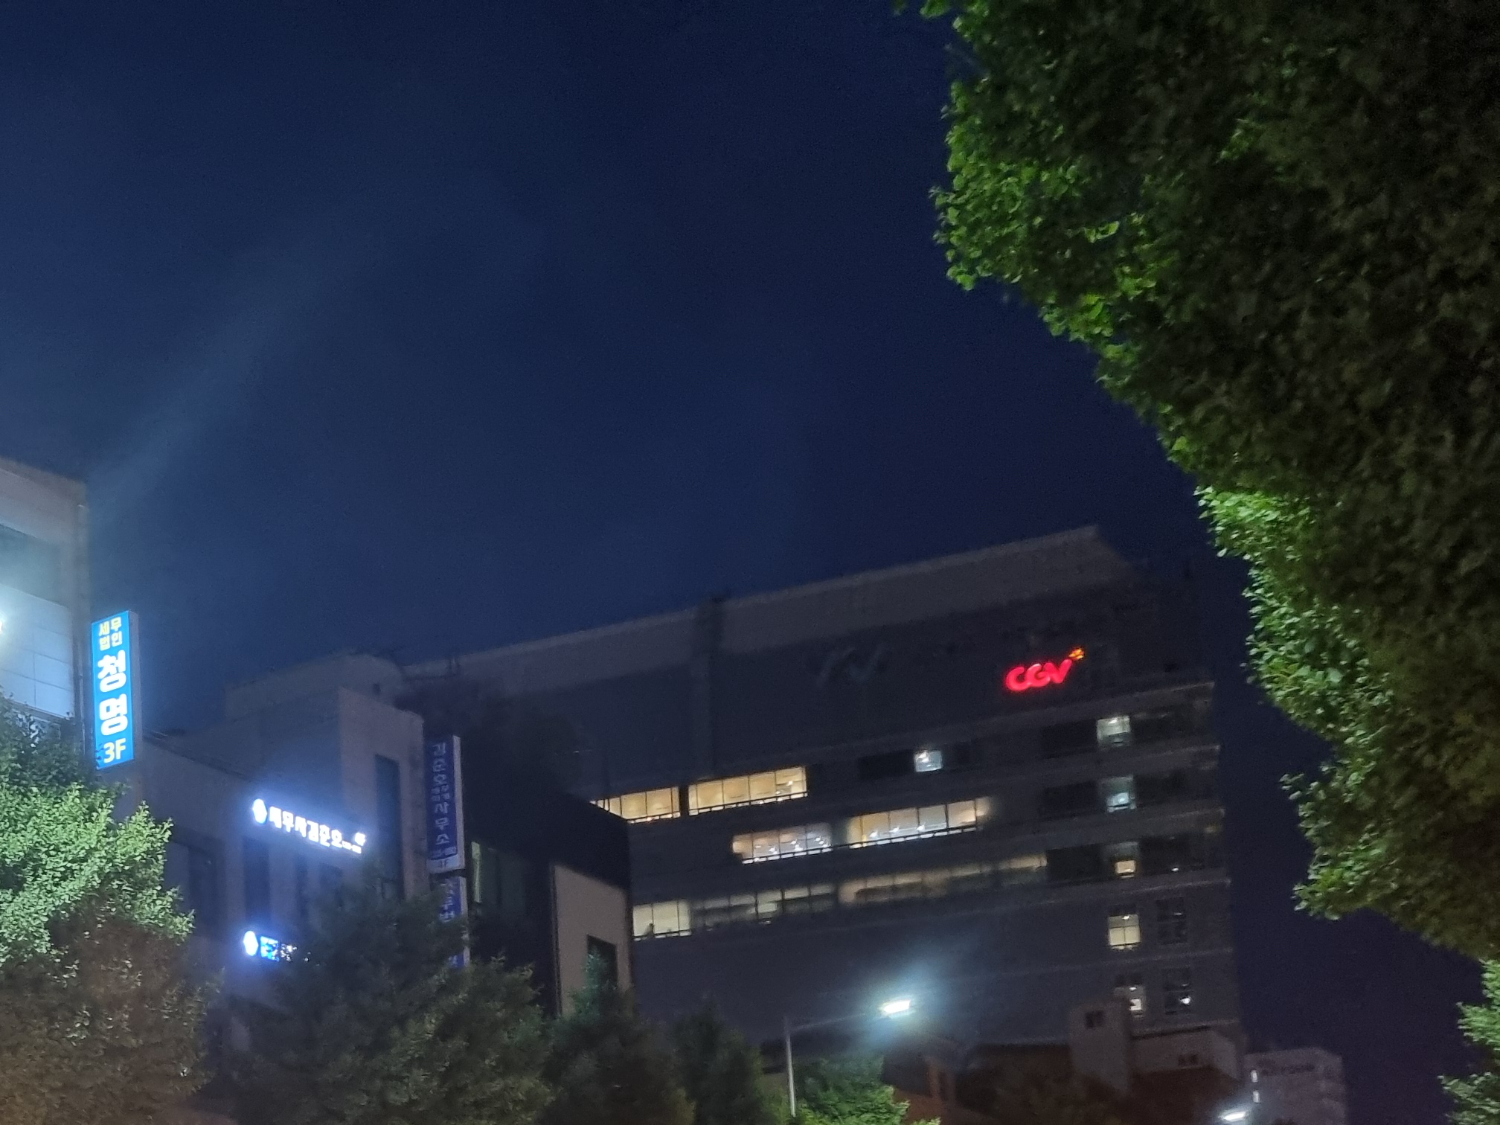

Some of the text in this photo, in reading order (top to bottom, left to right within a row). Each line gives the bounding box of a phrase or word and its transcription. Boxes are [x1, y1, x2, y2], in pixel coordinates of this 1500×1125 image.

[99, 616, 122, 636] 세무
[99, 630, 123, 651] 법인
[1005, 658, 1073, 691] CGV
[97, 649, 128, 736] 청명
[103, 737, 127, 764] 3F
